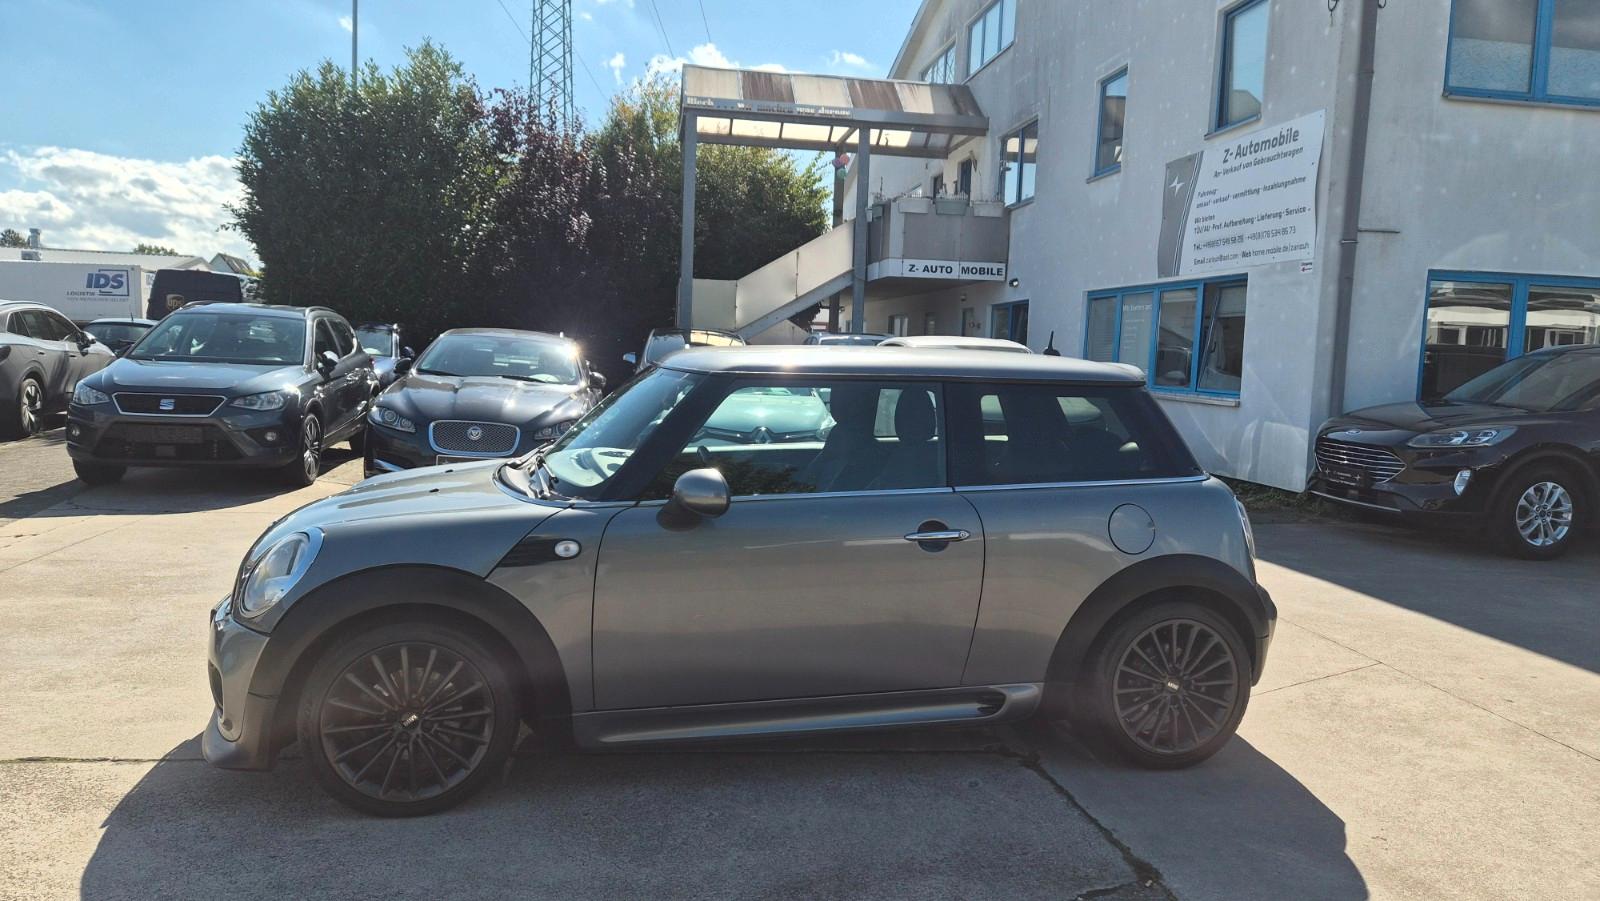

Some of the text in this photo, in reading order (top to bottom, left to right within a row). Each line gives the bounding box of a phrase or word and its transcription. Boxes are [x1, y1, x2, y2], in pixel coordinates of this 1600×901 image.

[1235, 127, 1300, 160] Automobile
[1243, 159, 1253, 169] von
[1254, 146, 1304, 165] Gebrauchtwagen
[1224, 214, 1255, 229] Aufbereitung
[1257, 209, 1282, 222] Lieferung
[1286, 205, 1306, 216] Service
[86, 272, 125, 289] IDS
[922, 264, 953, 274] AUTO
[961, 266, 1004, 277] MOBILE
